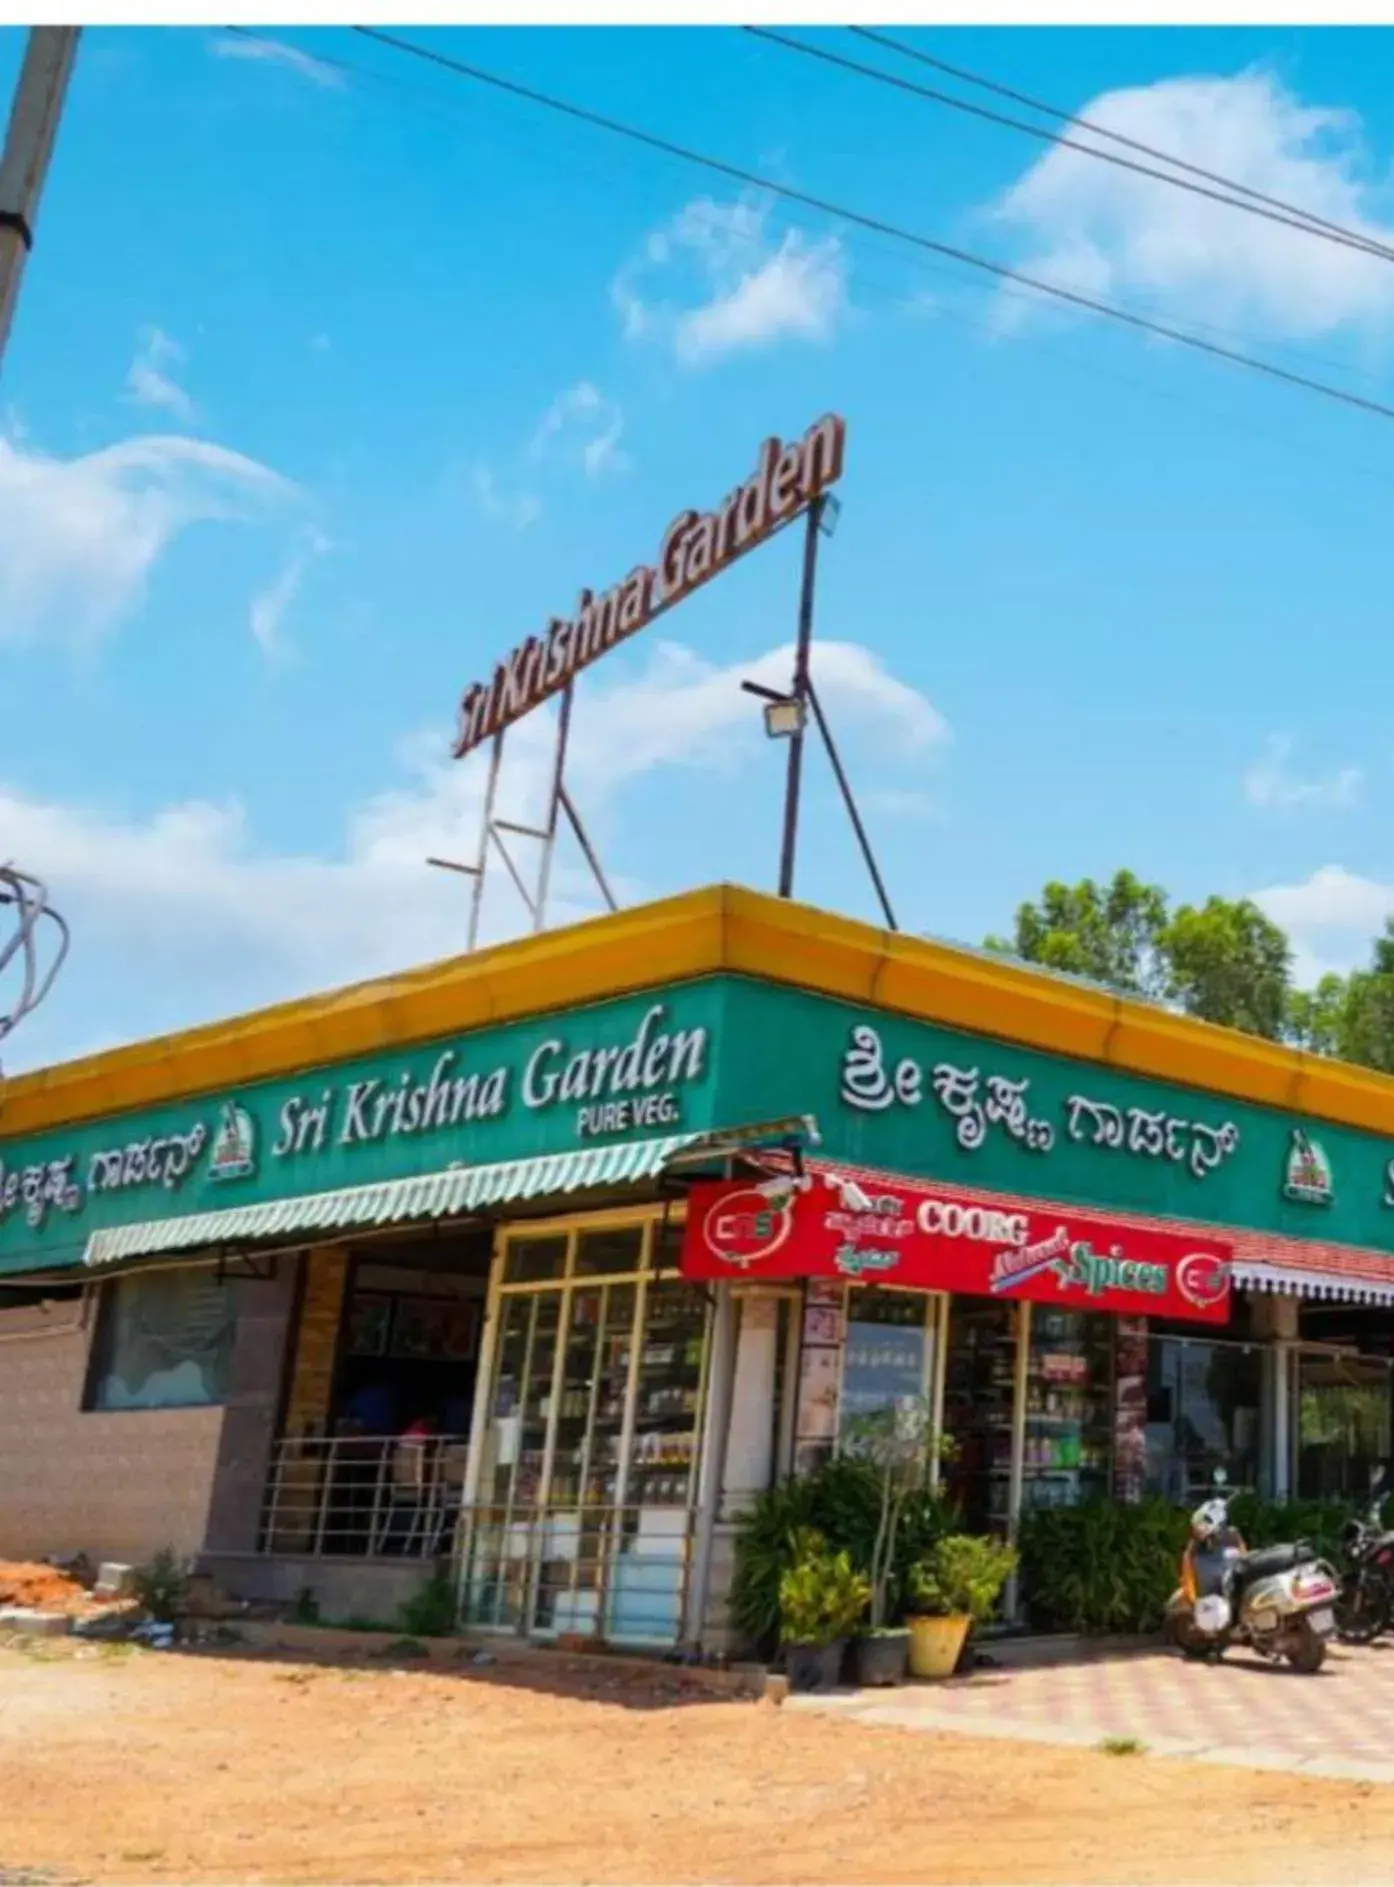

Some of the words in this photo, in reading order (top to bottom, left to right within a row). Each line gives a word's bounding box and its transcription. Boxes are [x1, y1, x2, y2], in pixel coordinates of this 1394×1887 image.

[494, 565, 657, 725] Krishna
[651, 412, 845, 609] Garden
[272, 1090, 333, 1156] Sri
[341, 1051, 508, 1146] Krishna
[521, 1004, 708, 1109] Garden
[577, 1103, 628, 1137] PURE
[917, 1200, 1029, 1245] COORG
[1050, 1241, 1169, 1296] Spices
